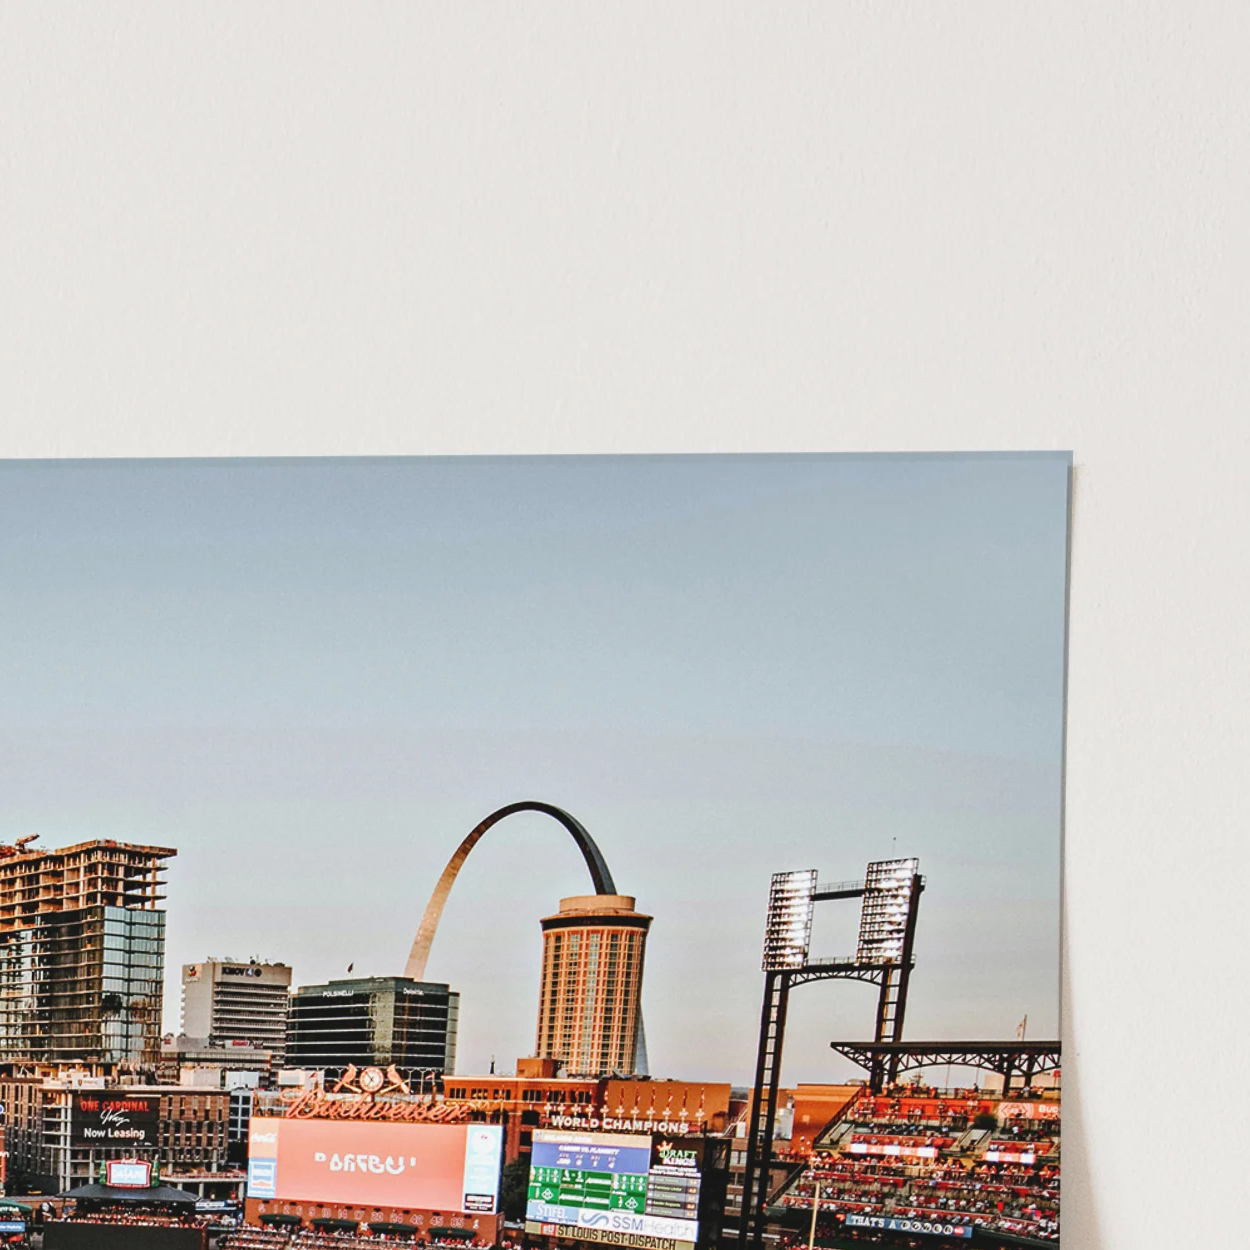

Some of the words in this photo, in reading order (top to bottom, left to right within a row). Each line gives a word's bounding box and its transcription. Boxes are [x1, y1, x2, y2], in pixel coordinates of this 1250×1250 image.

[81, 1100, 100, 1111] ONE
[102, 1101, 149, 1111] CARDINAL
[280, 1087, 470, 1121] Budweiser
[551, 1115, 599, 1128] WORLD
[602, 1117, 689, 1133] CHAMPIONS
[84, 1128, 106, 1138] Now
[108, 1128, 145, 1140] Leasing
[572, 1226, 598, 1240] LOUIS
[601, 1230, 676, 1250] POST-DISPATCH
